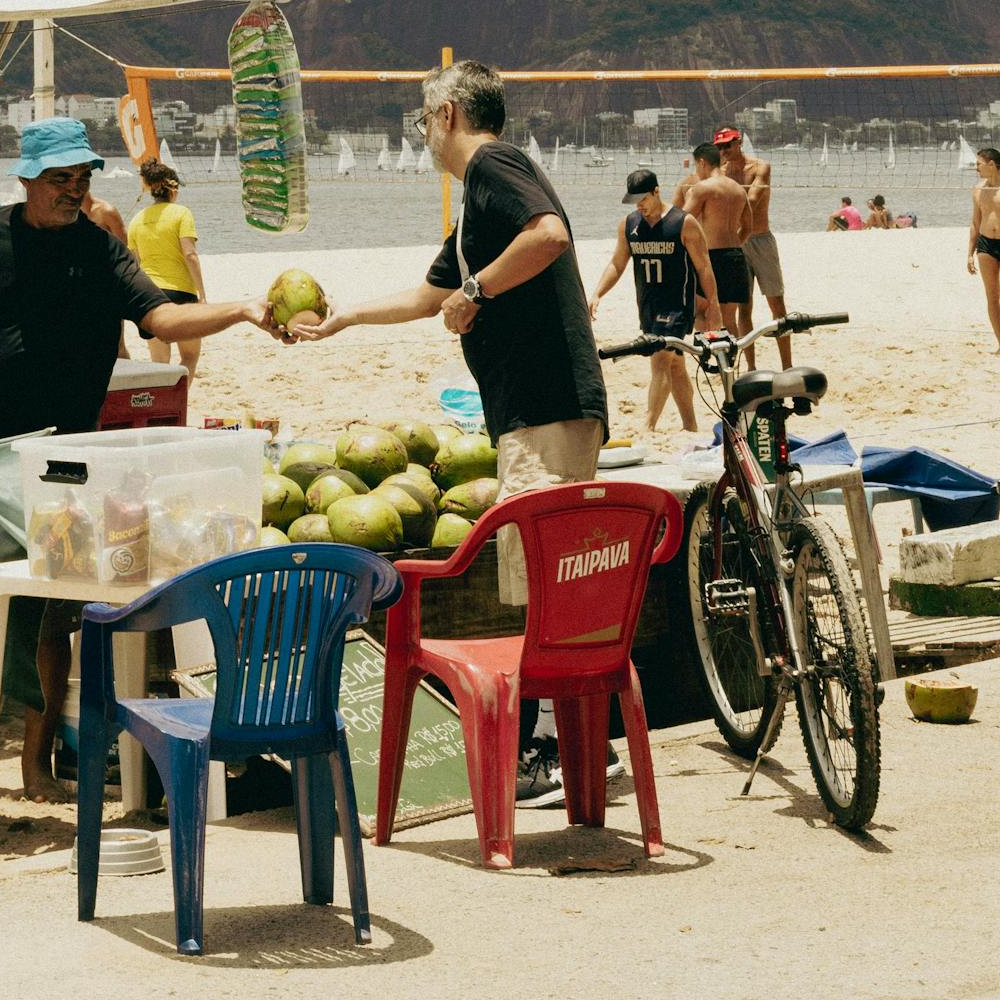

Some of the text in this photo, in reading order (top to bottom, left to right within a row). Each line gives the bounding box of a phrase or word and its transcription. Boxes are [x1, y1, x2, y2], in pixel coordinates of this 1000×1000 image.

[640, 258, 663, 284] 77
[756, 417, 772, 463] SPATEN
[556, 540, 630, 584] ITAIPAVA
